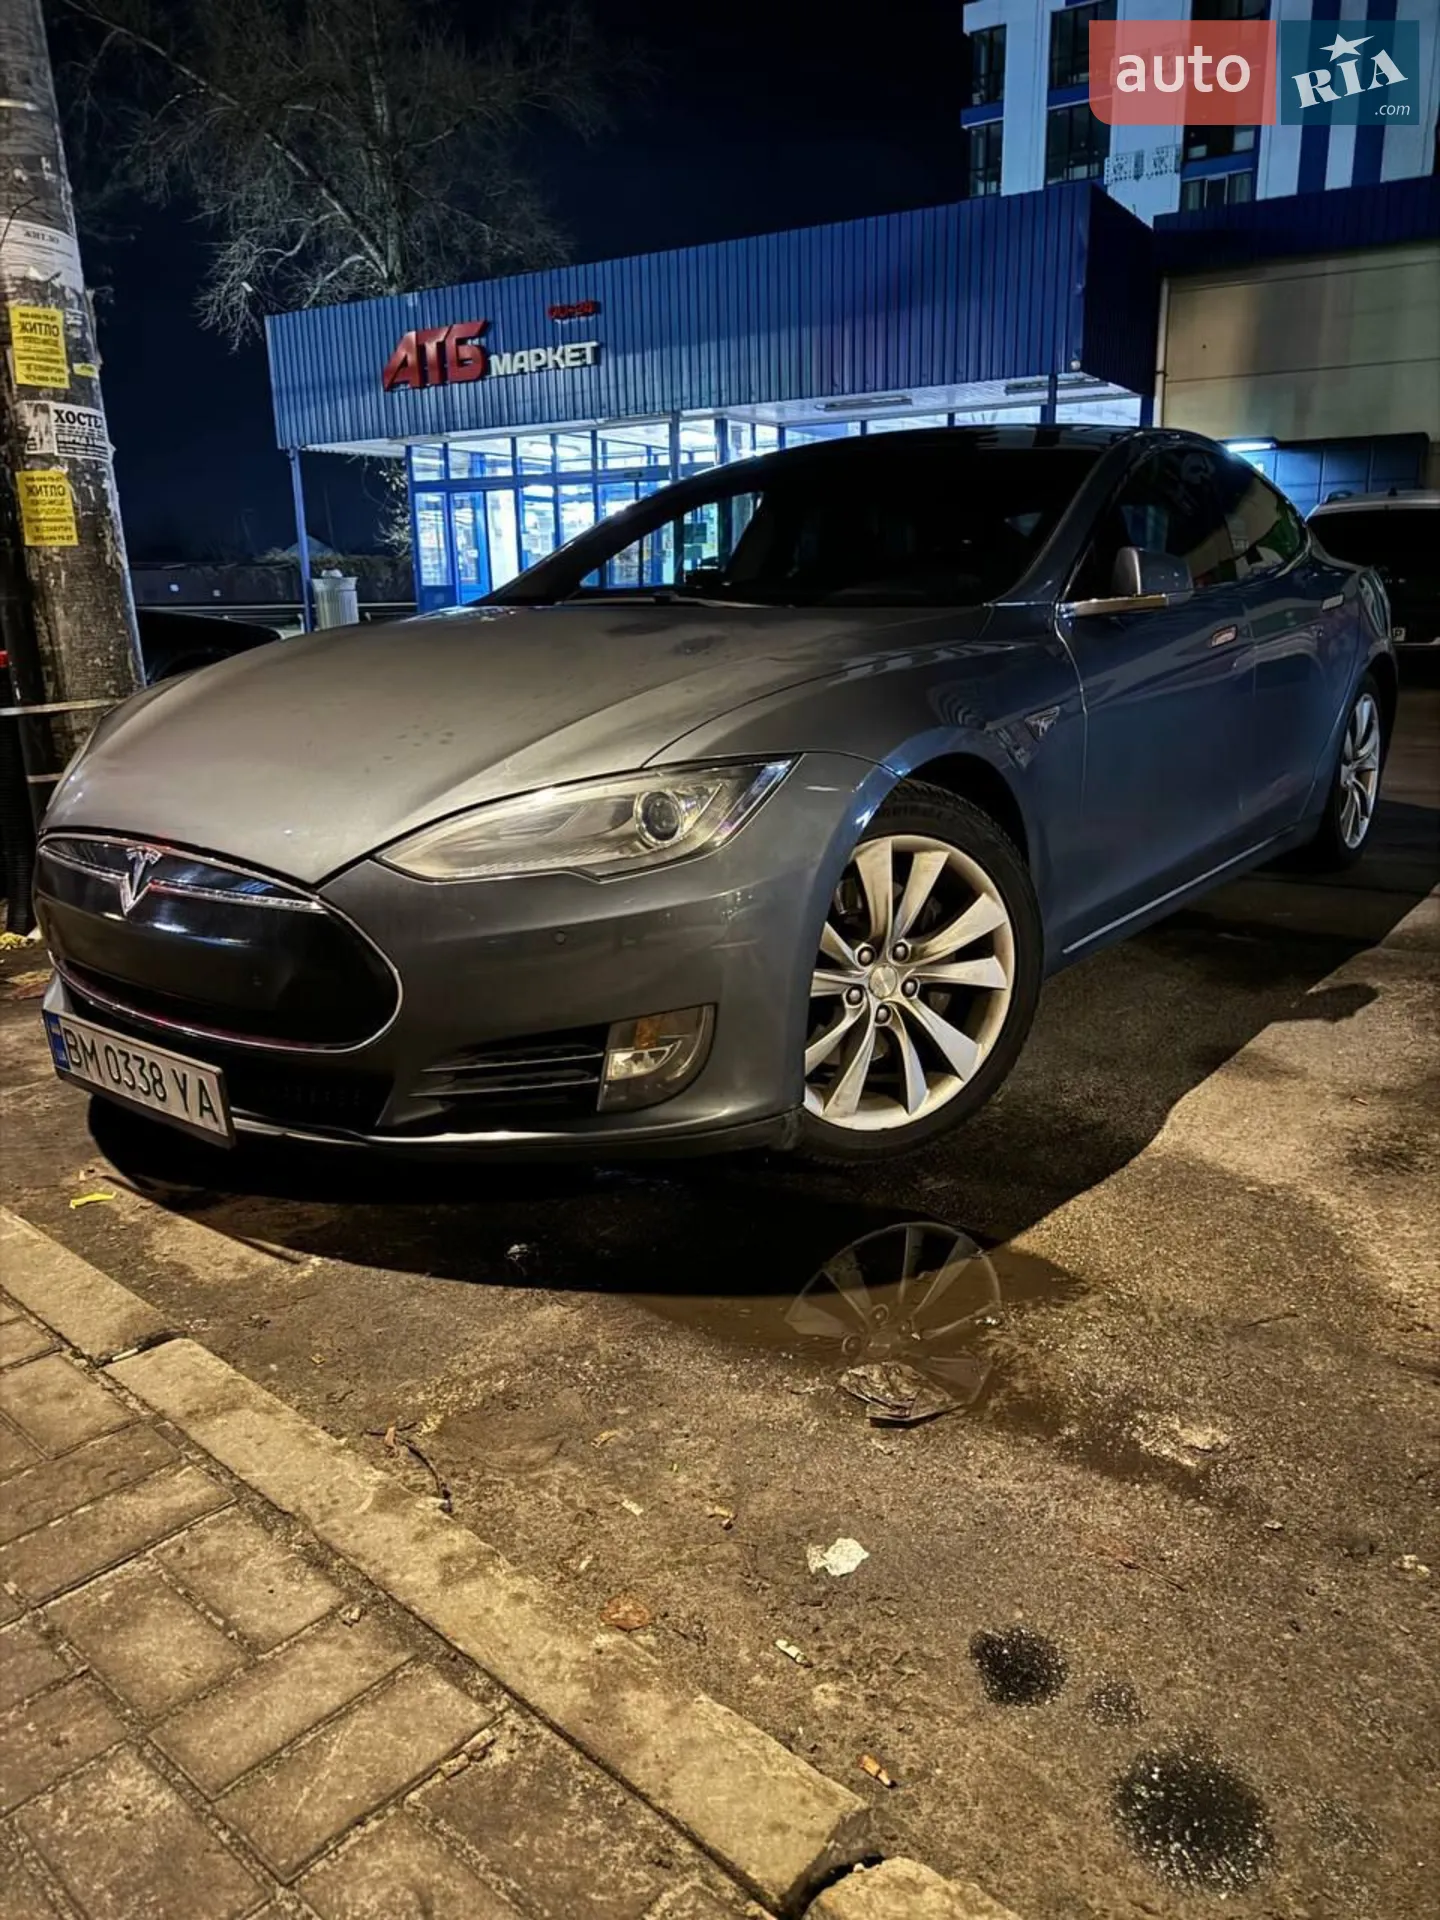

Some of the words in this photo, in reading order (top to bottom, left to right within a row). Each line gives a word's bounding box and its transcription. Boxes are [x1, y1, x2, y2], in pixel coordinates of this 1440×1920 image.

[20, 322, 60, 337] ЖИТЛО
[489, 341, 599, 377] МАРКЕТ
[63, 1028, 104, 1081] BM
[105, 1045, 167, 1103] 0338
